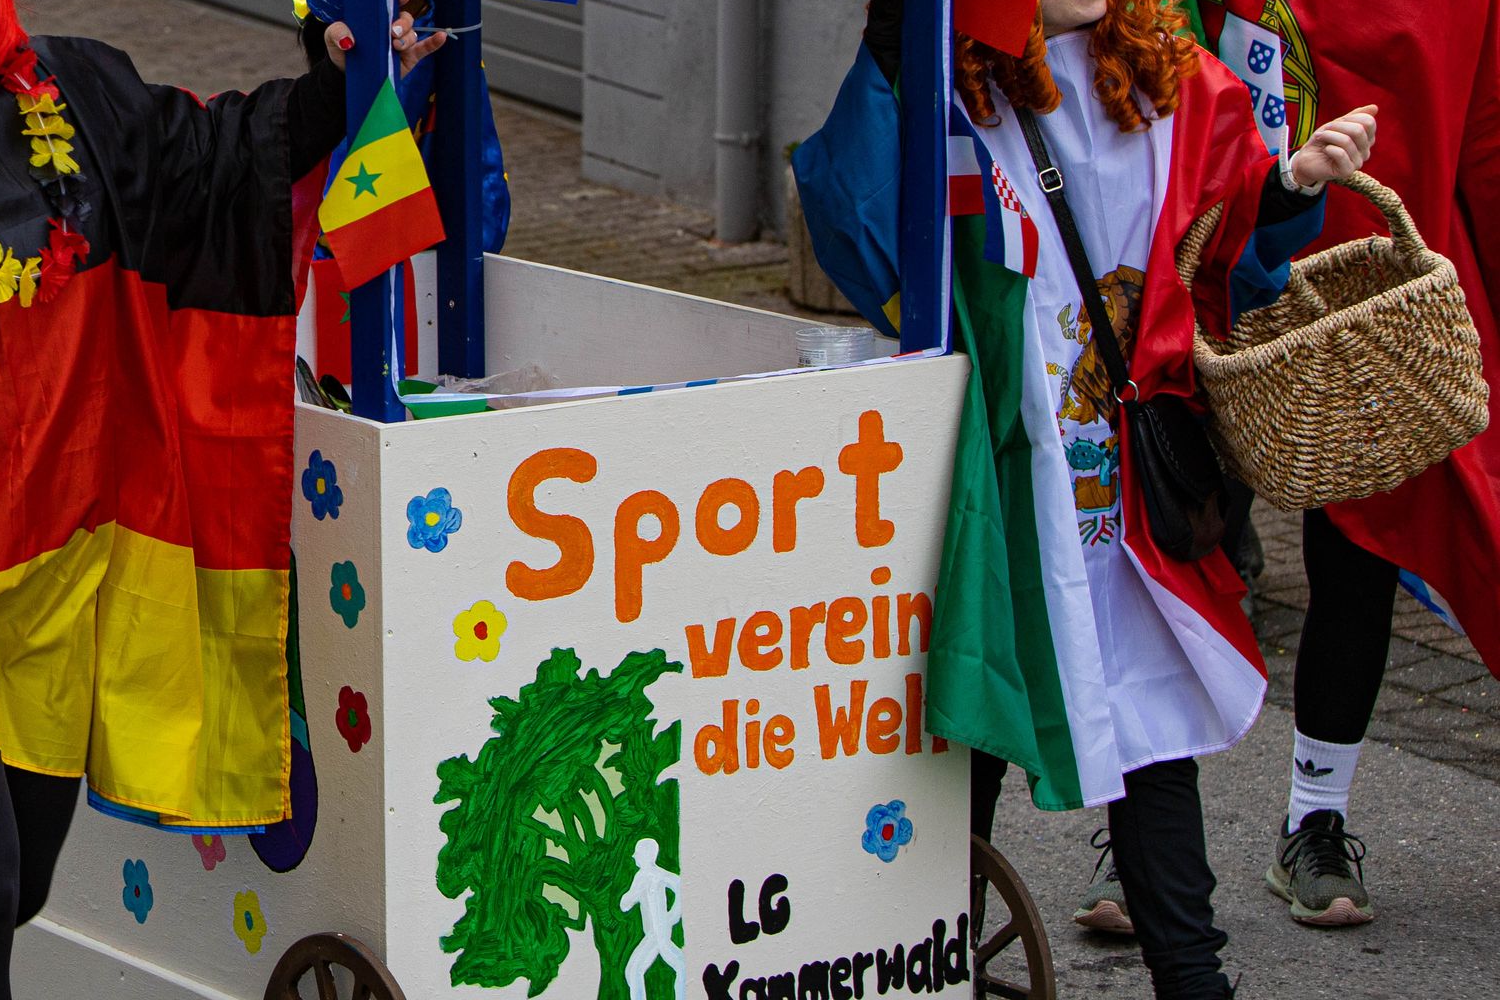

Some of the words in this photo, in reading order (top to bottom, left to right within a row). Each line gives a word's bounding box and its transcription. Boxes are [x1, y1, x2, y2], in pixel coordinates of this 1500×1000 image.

[505, 409, 904, 624] Sport
[684, 566, 938, 680] verein
[692, 698, 797, 777] die
[727, 873, 792, 945] LG
